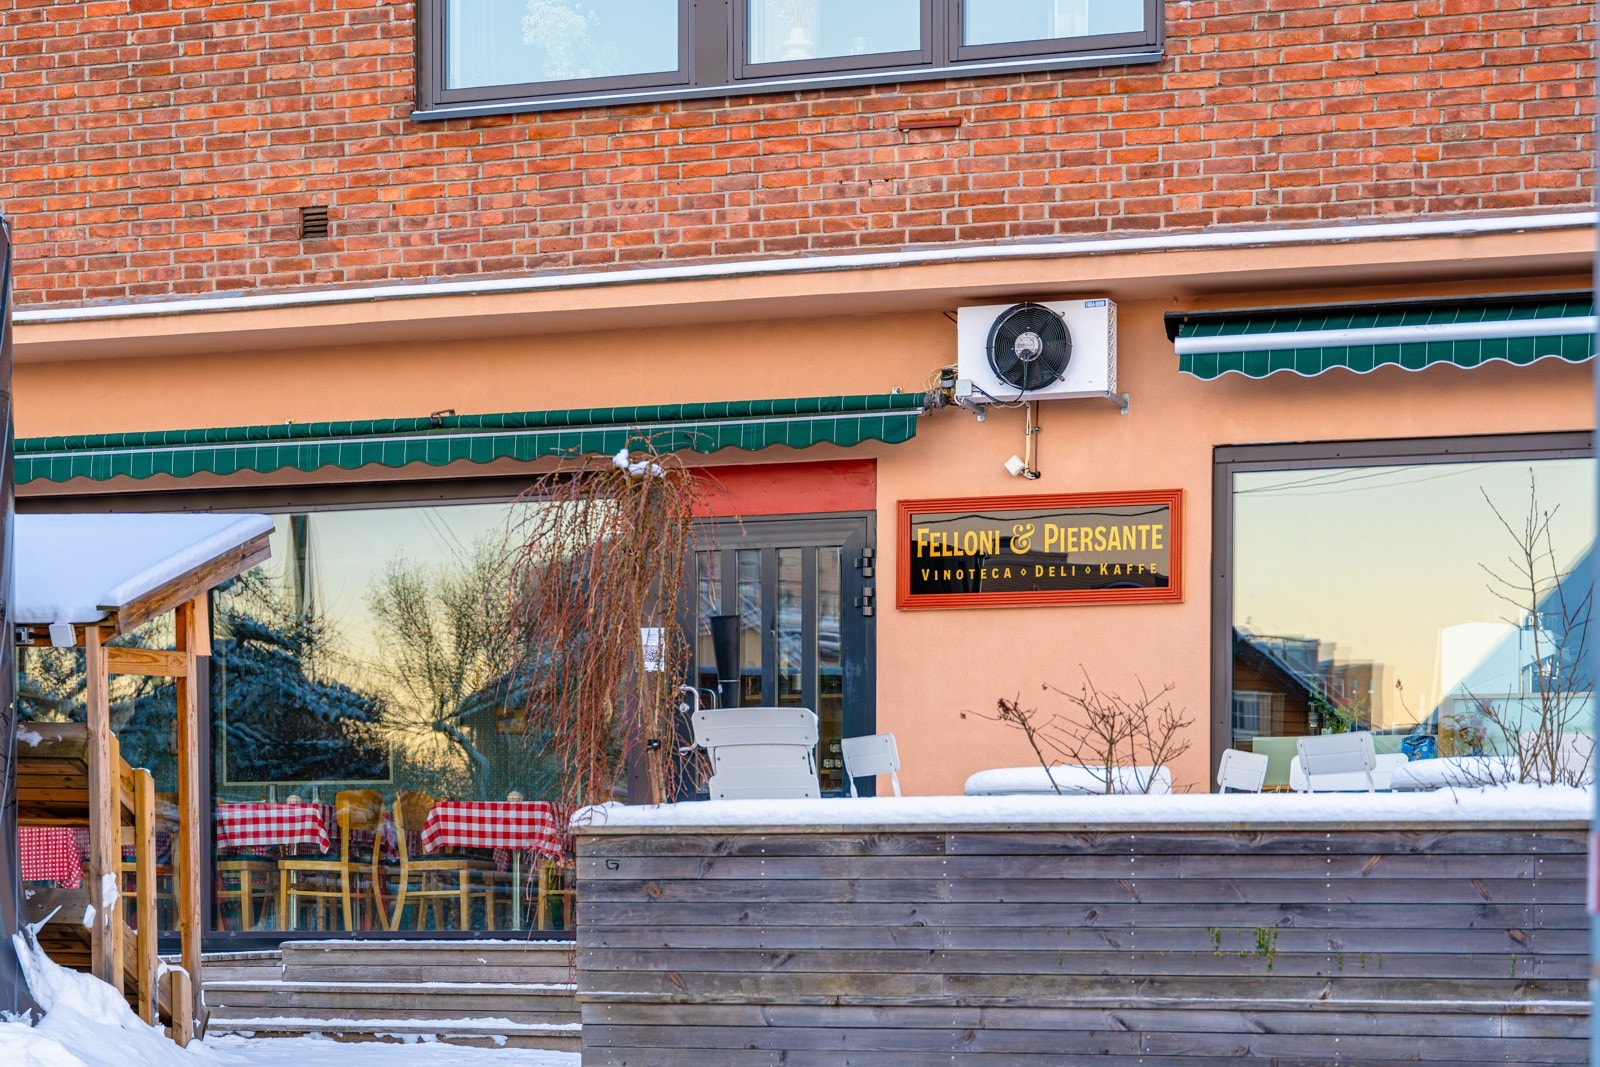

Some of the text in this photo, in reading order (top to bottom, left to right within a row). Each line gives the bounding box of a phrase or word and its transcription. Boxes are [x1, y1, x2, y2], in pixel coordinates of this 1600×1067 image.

[917, 523, 1163, 557] FELLONI & PIERSANTE
[921, 563, 1157, 581] VINOTECA DELI KAFFE
